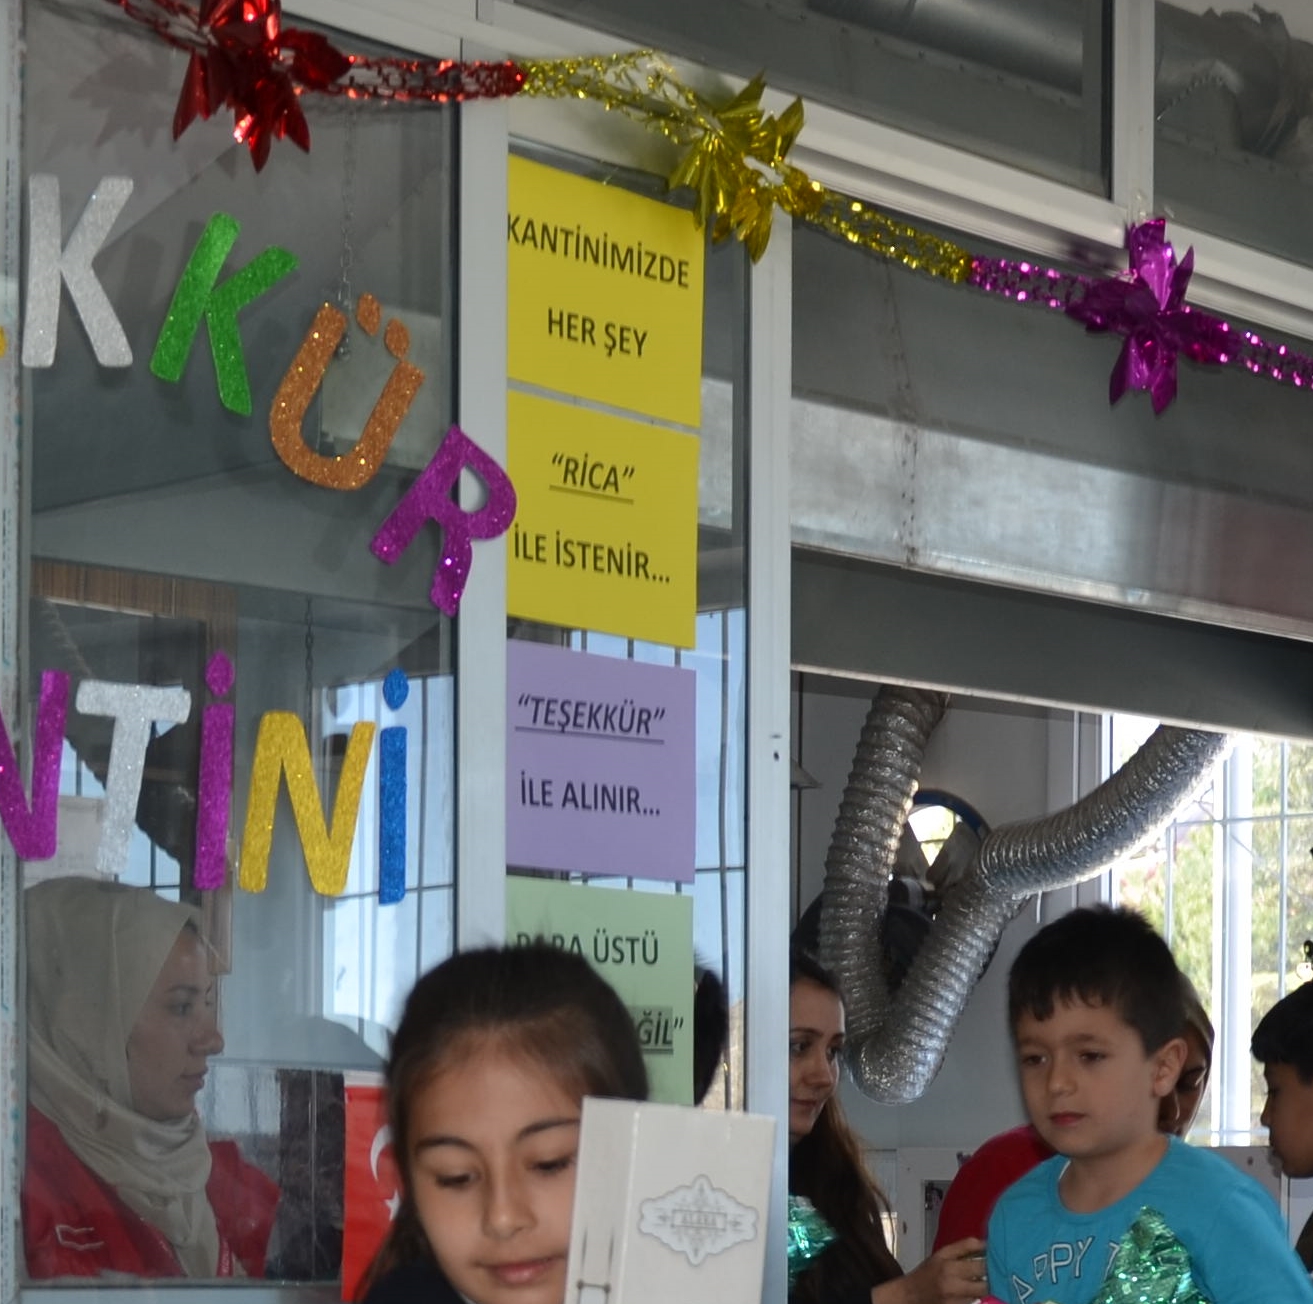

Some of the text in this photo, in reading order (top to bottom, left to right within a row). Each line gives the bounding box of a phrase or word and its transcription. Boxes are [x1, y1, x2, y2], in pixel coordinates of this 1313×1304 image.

[507, 212, 691, 290] KANTİNİMİZDE
[547, 307, 649, 358] HER ŞEY
[551, 452, 636, 495] “RİCA”
[513, 523, 672, 584] İLE İSTENİR...
[517, 693, 665, 737] “TEŞEKKÜR”
[520, 770, 661, 817] İLE ALINIR...
[516, 927, 659, 965] PRA ÜSTÜ
